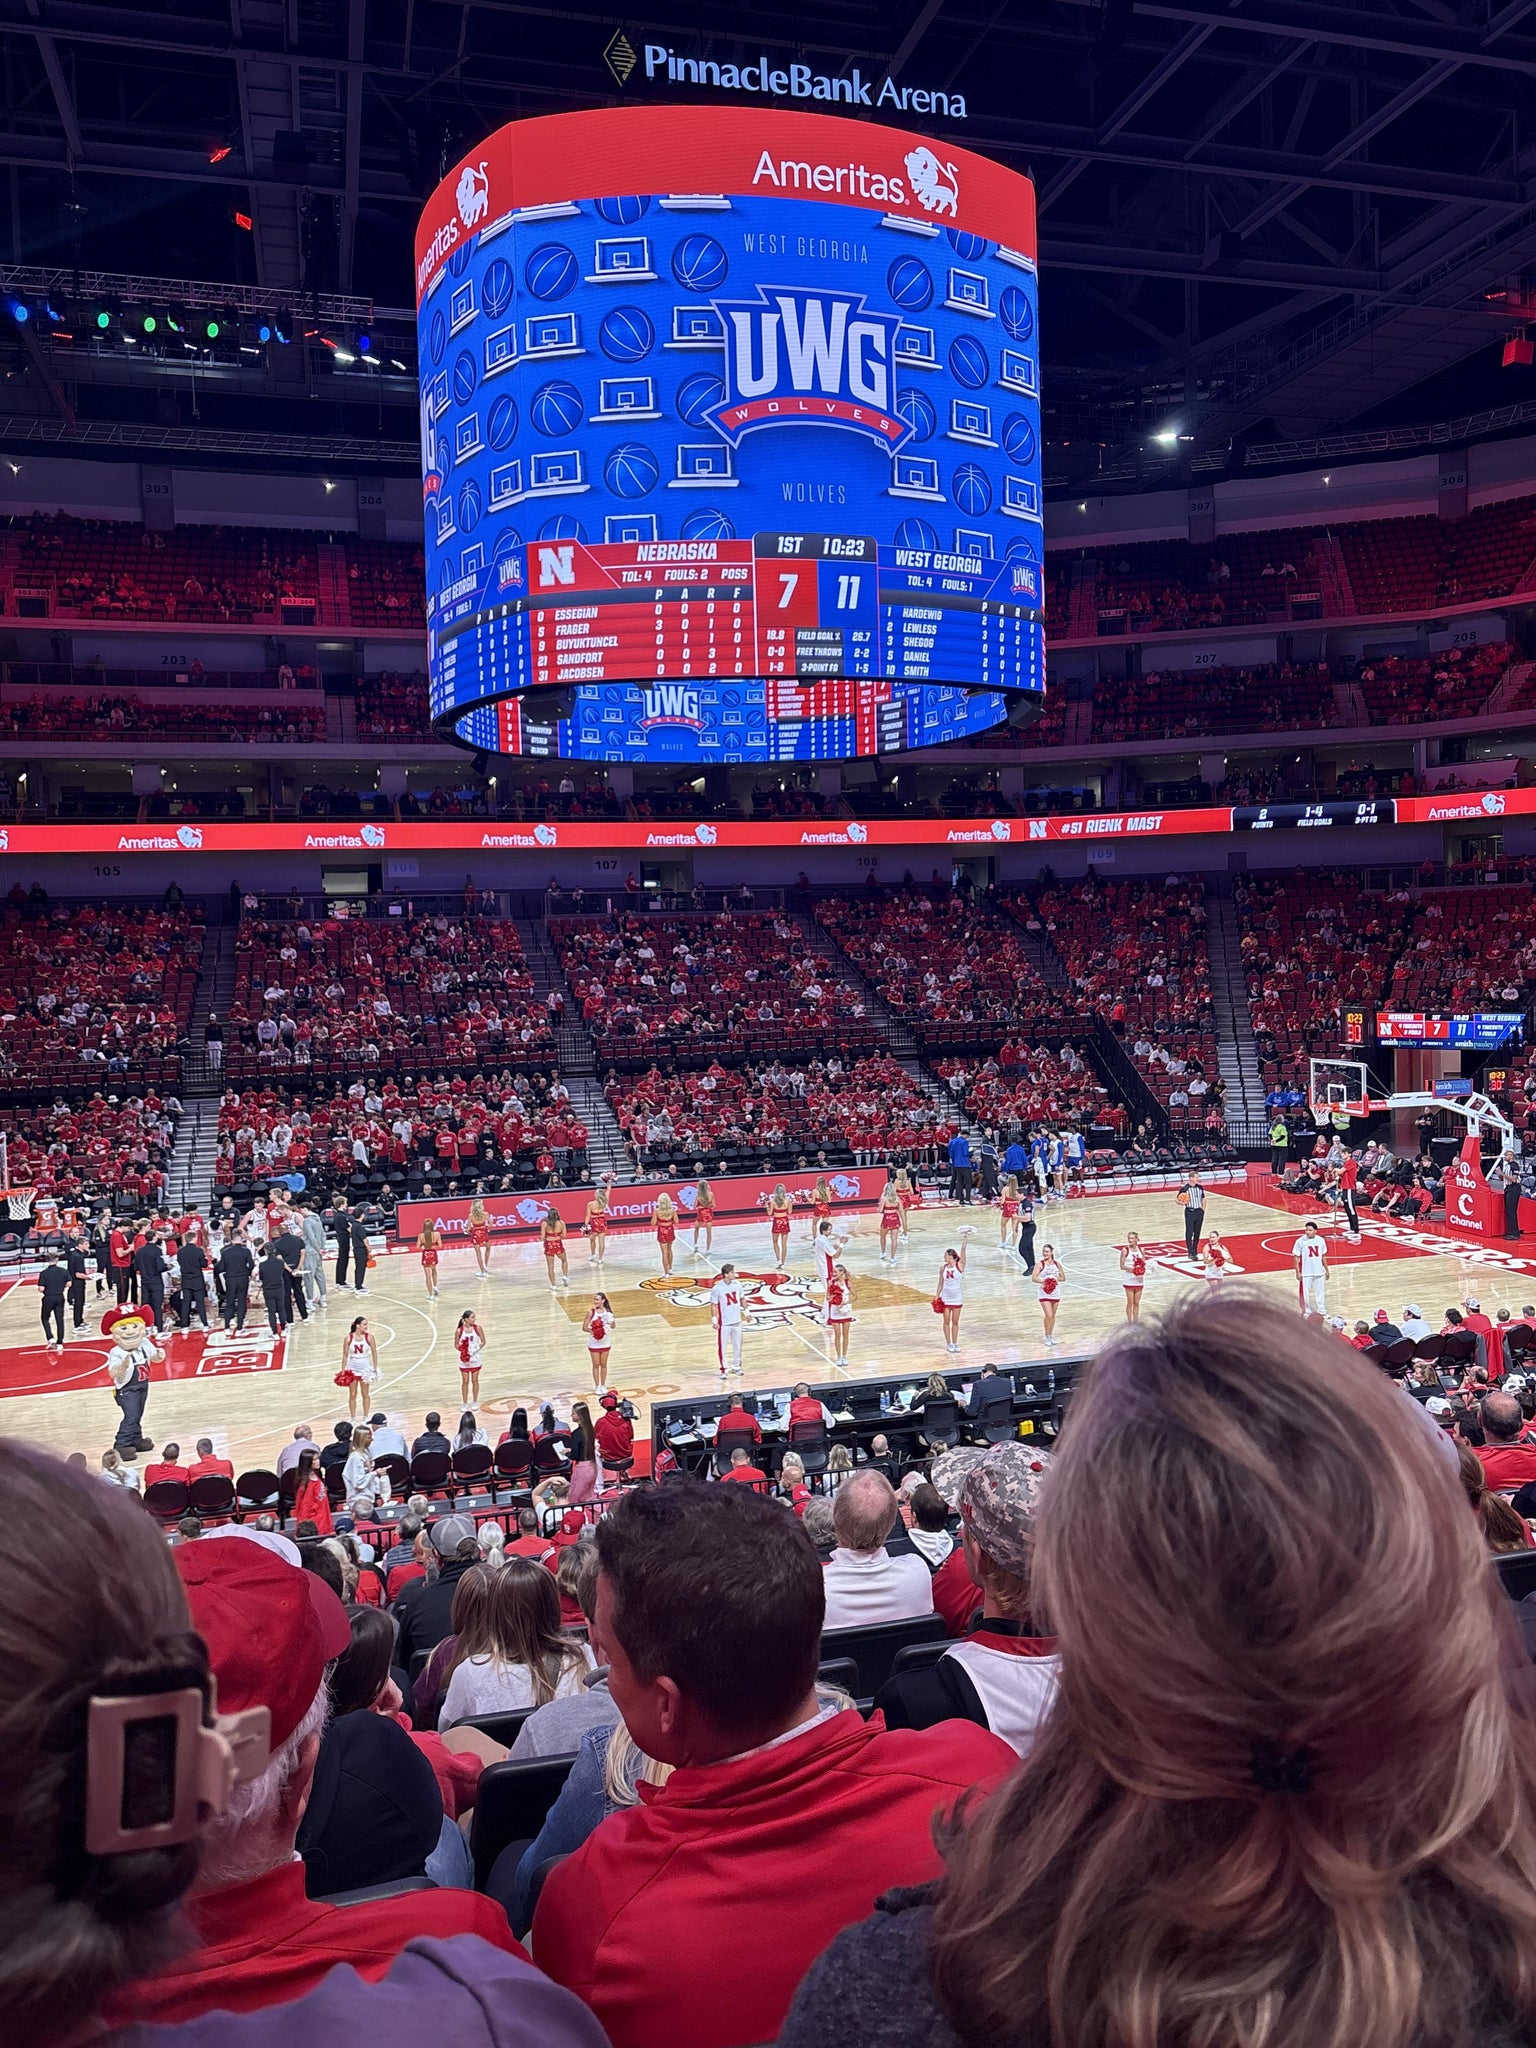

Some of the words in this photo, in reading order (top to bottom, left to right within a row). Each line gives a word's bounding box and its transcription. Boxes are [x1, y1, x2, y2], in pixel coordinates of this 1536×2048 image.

[644, 44, 872, 105] PinnacleBank
[876, 77, 968, 119] Arena
[752, 150, 904, 203] Ameritas
[744, 233, 786, 254] WEST
[798, 237, 868, 264] GEORGIA
[728, 296, 888, 410] UWG
[735, 400, 890, 430] WOLVES
[1440, 474, 1464, 486] 308
[145, 484, 169, 494] 303
[782, 482, 846, 504] WOLVES
[1190, 501, 1212, 512] 307
[636, 543, 718, 562] NEBRASKA
[777, 536, 803, 554] 1ST
[822, 538, 865, 556] 10:23
[538, 546, 575, 587] N
[895, 550, 931, 569] WEST
[933, 554, 982, 574] GEORGIA
[500, 558, 520, 583] UWG
[621, 571, 642, 582] TOL:
[644, 570, 652, 581] 4
[664, 569, 699, 581] FOULS:
[700, 569, 708, 579] 2
[721, 568, 748, 579] POSS
[907, 576, 925, 586] TOL:
[926, 577, 933, 588] 4
[942, 578, 967, 591] FOULS:
[968, 582, 973, 592] 1
[1012, 566, 1034, 589] UWG
[655, 589, 663, 600] P
[681, 589, 689, 599] A
[707, 588, 715, 598] R
[734, 587, 741, 598] F
[778, 574, 798, 608] 7
[836, 576, 862, 610] 11
[537, 612, 544, 622] 0
[554, 608, 598, 621] ESSEGIAN
[655, 604, 662, 615] 0
[681, 604, 688, 614] 0
[707, 603, 714, 613] 0
[733, 602, 740, 613] 0
[887, 606, 892, 617] 1
[902, 607, 943, 621] HARDEWIG
[538, 626, 545, 637] 5
[556, 623, 590, 636] FRAGER
[655, 619, 663, 630] 3
[682, 618, 689, 629] 0
[708, 618, 713, 629] 1
[734, 618, 741, 629] 0
[886, 622, 893, 632] 2
[902, 622, 938, 635] LEWLESS
[538, 641, 545, 651] 9
[556, 636, 619, 650] BUYUKTUNCEL
[656, 634, 663, 644] 0
[683, 633, 687, 644] 1
[709, 633, 714, 643] 1
[734, 632, 741, 643] 0
[766, 630, 785, 641] 18.8
[797, 631, 816, 640] FIELD
[817, 631, 834, 640] GOAL
[852, 632, 871, 642] 26.7
[886, 636, 893, 646] 3
[903, 636, 934, 648] SHEGOG
[1453, 631, 1477, 643] 208
[538, 656, 548, 666] 21
[557, 652, 604, 665] SANDFORT
[656, 649, 664, 659] 0
[682, 649, 690, 659] 0
[709, 648, 716, 658] 3
[735, 648, 740, 658] 1
[767, 646, 785, 657] 0-0
[796, 647, 813, 656] FREE
[814, 647, 842, 656] THROWS
[853, 648, 870, 658] 2-2
[887, 650, 894, 660] 5
[904, 650, 930, 663] DANIEL
[160, 654, 187, 666] 203
[1195, 653, 1217, 665] 207
[538, 670, 548, 681] 31
[557, 667, 604, 680] JACOBSEN
[657, 664, 664, 675] 0
[683, 663, 690, 674] 0
[709, 663, 717, 673] 2
[734, 662, 742, 673] 0
[768, 662, 784, 672] 1-8
[801, 662, 829, 672] 3-POINT
[829, 663, 839, 672] FG
[855, 663, 869, 673] 1-5
[886, 664, 896, 675] 10
[904, 665, 929, 677] SMITH
[646, 686, 699, 719] UWG
[1259, 809, 1267, 820] 2
[1305, 805, 1324, 818] 1-4
[1357, 803, 1376, 815] 0-1
[1428, 804, 1482, 819] Ameritas
[1061, 822, 1083, 834] #51
[1085, 818, 1123, 833] RIENK
[1126, 816, 1163, 831] MAST
[1251, 820, 1274, 829] POINTS
[1314, 817, 1333, 826] GOALS
[947, 829, 992, 842] Ameritas
[1029, 821, 1047, 838] N
[118, 836, 178, 849] Ameritas
[304, 834, 362, 847] Ameritas
[481, 833, 535, 846] Ameritas
[646, 832, 696, 845] Ameritas
[801, 831, 848, 843] Ameritas
[595, 860, 618, 871] 107
[856, 857, 878, 867] 108
[94, 866, 121, 876] 105
[1348, 1024, 1361, 1043] 30
[1380, 1023, 1392, 1035] N
[1434, 1024, 1441, 1035] 7
[1458, 1024, 1466, 1035] 11
[1436, 1083, 1452, 1091] smith
[1491, 1080, 1502, 1091] 30
[1456, 1175, 1476, 1189] fnbo
[1450, 1215, 1483, 1230] Channel
[1307, 1245, 1319, 1257] N
[946, 1270, 954, 1279] N
[725, 1291, 738, 1305] N
[120, 1304, 135, 1315] N
[354, 1344, 364, 1353] N
